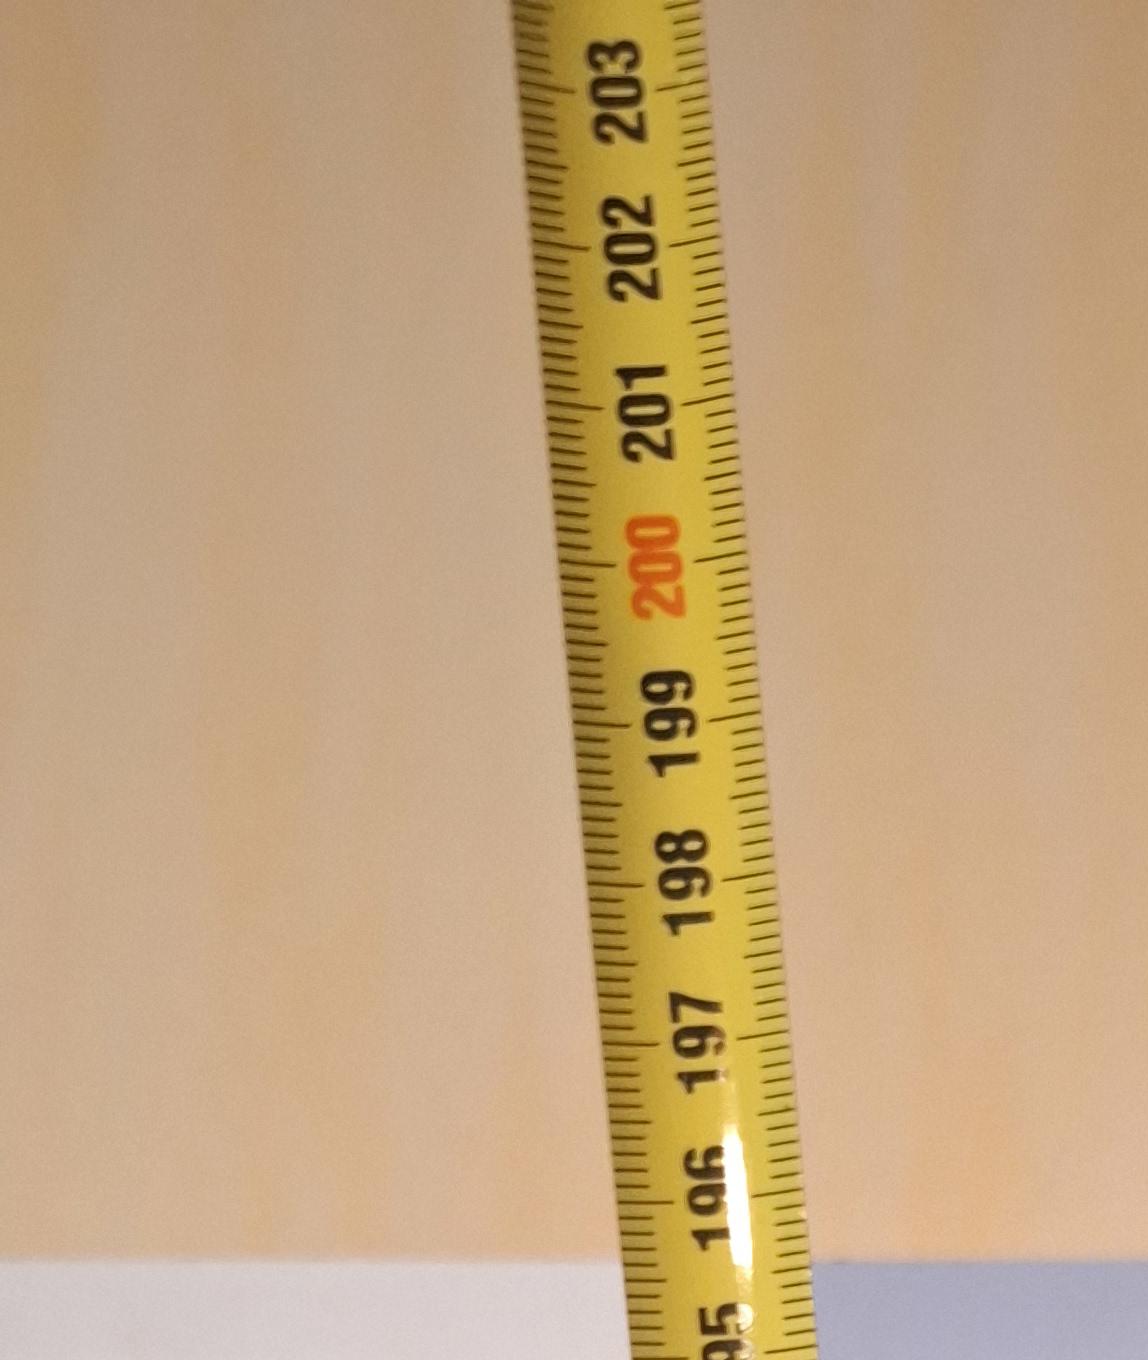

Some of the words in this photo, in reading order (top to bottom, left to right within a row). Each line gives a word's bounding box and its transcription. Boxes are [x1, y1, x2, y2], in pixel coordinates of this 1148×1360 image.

[584, 40, 647, 145] 203
[598, 196, 661, 302] 202
[614, 365, 674, 463] 201
[625, 517, 683, 619] 200
[640, 670, 699, 777] 199
[654, 829, 712, 936] 198
[668, 991, 727, 1094] 197
[683, 1144, 737, 1252] 196
